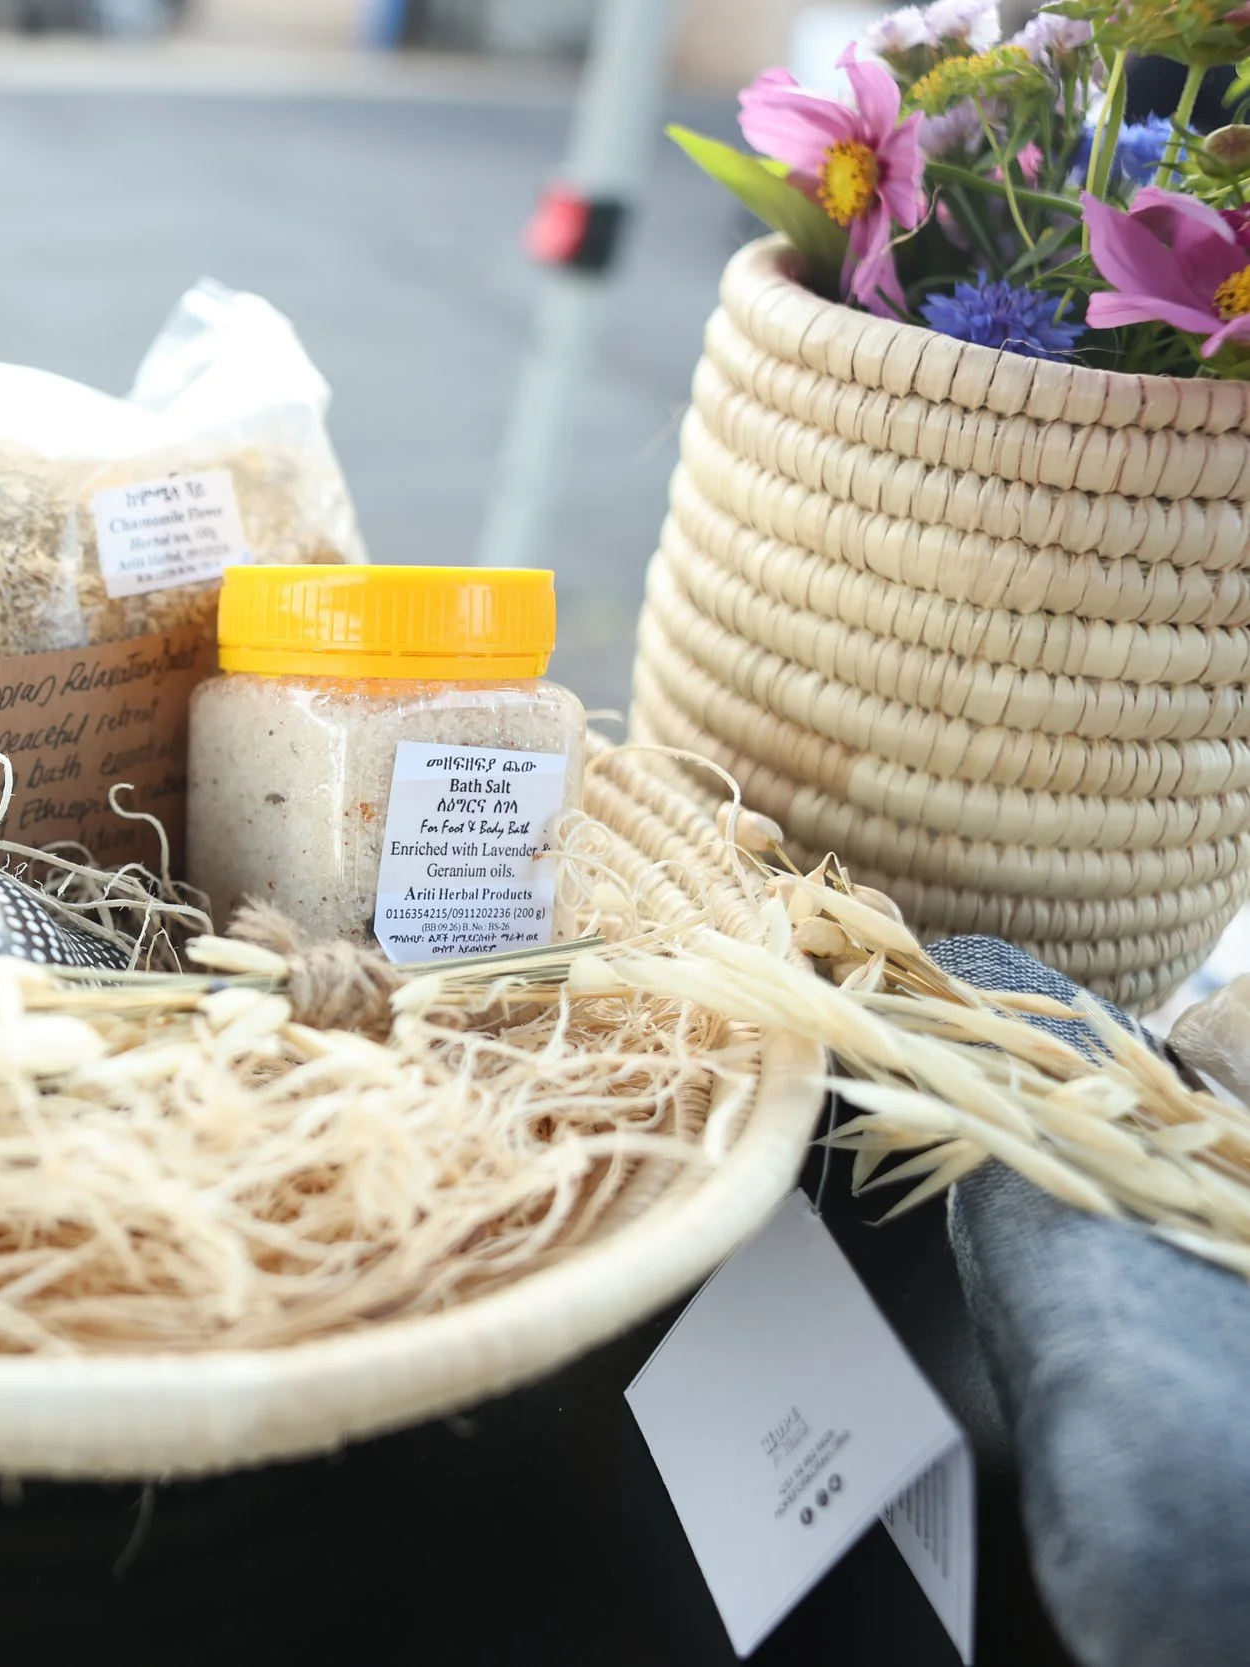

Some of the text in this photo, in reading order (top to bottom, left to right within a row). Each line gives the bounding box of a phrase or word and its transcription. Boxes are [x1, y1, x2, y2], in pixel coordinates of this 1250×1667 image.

[26, 750, 82, 788] bath
[502, 760, 537, 773] ጨው
[449, 778, 511, 794] Bath Salt
[493, 799, 518, 814] ለገላ
[420, 818, 531, 839] For Foot & Body Bath
[390, 841, 448, 856] Enriched
[451, 842, 478, 857] with
[482, 842, 538, 858] Lavender
[426, 862, 516, 878] Geranium oils.
[403, 886, 533, 901] Ariti Herbal Products
[385, 907, 546, 920] 0116354215/0911202236 (200 g)
[488, 922, 510, 932] BS-26
